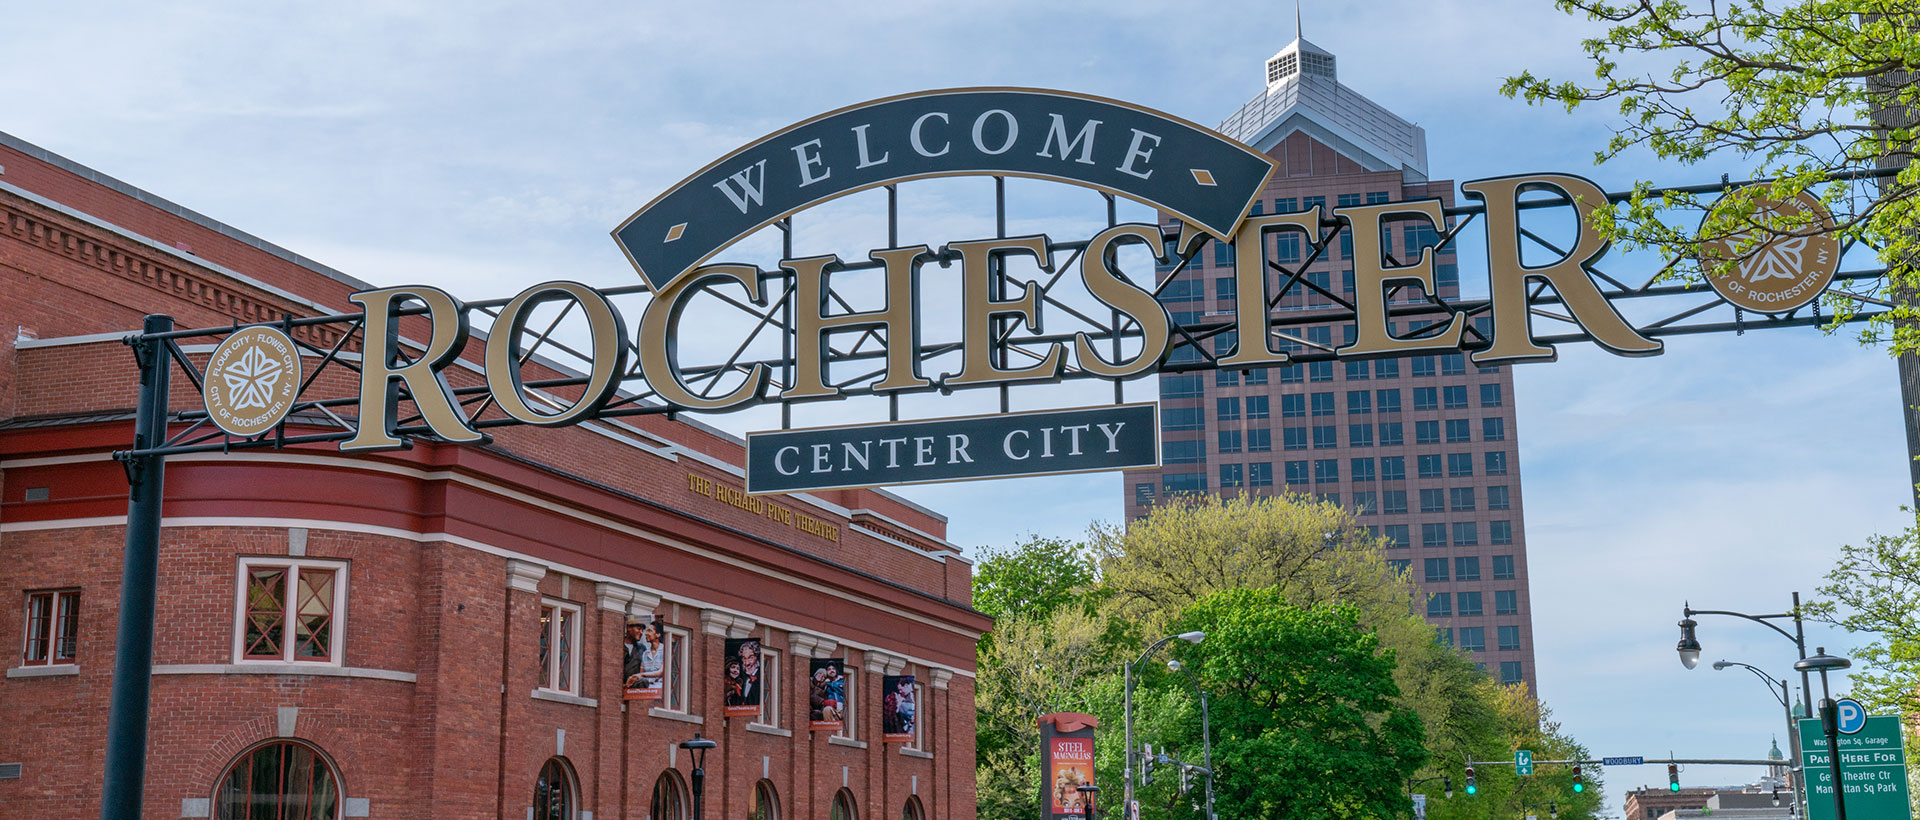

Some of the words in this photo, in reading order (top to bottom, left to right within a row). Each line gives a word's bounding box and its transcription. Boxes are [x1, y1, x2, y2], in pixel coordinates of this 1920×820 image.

[713, 110, 1162, 214] WELCOME
[1728, 280, 1746, 294] OF
[1748, 270, 1824, 302] ROCHESTER,
[1816, 247, 1830, 264] NY
[338, 172, 1664, 451] ROCHESTER
[213, 348, 233, 377] FLOUR
[231, 335, 250, 351] CITY
[257, 334, 288, 356] FLOWER
[283, 355, 294, 375] CITY
[211, 386, 223, 408] CITY
[219, 408, 232, 420] OF
[231, 401, 286, 428] ROCHESTER,
[282, 382, 293, 397] NY
[774, 432, 975, 477] CENTER
[1002, 421, 1127, 459] CITY
[687, 473, 712, 497] THE
[715, 483, 764, 515] RICHARD
[766, 502, 792, 526] PINE
[794, 512, 839, 543] THEATRE
[1840, 705, 1857, 728] P
[1058, 742, 1085, 752] STEEL
[1814, 738, 1852, 747] Wasgton
[1853, 737, 1863, 746] Sq.
[1865, 736, 1889, 746] Garage
[1053, 752, 1091, 760] MAGNOLIAS
[1604, 757, 1641, 765] WOODBURY
[1810, 754, 1830, 764] PAR
[1841, 753, 1870, 763] HERE
[1874, 752, 1896, 762] FOR
[1843, 771, 1875, 781] Theatre
[1878, 770, 1891, 780] Ctr
[1816, 784, 1861, 794] Manttan
[1863, 784, 1875, 795] Sq
[1877, 783, 1897, 793] Park
